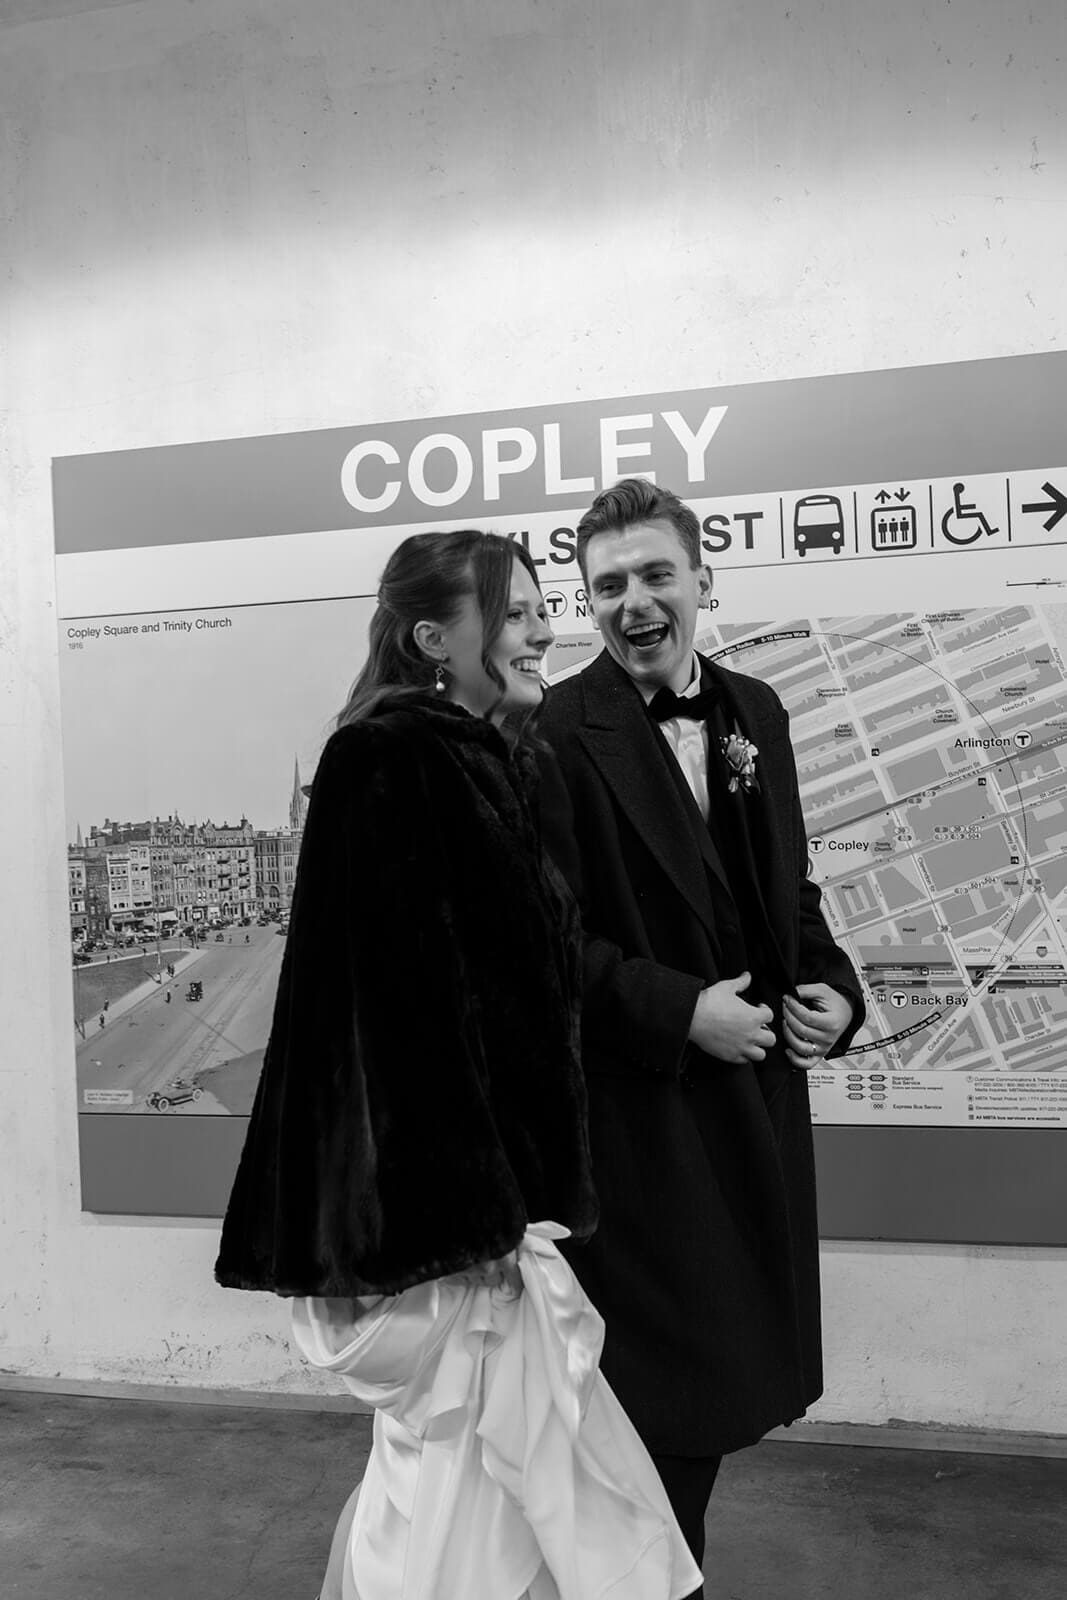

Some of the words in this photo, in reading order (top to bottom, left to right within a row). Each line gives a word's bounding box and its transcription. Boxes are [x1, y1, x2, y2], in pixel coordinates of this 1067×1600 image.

[341, 405, 729, 513] COPLEY
[702, 511, 763, 553] ST
[67, 627, 101, 639] Copley
[104, 624, 139, 637] Square
[141, 622, 160, 633] and
[163, 620, 193, 632] Trinity
[195, 617, 232, 630] Church
[954, 737, 1011, 750] Arlington
[828, 840, 870, 852] Copley
[911, 995, 942, 1005] Back
[946, 995, 969, 1007] Bay
